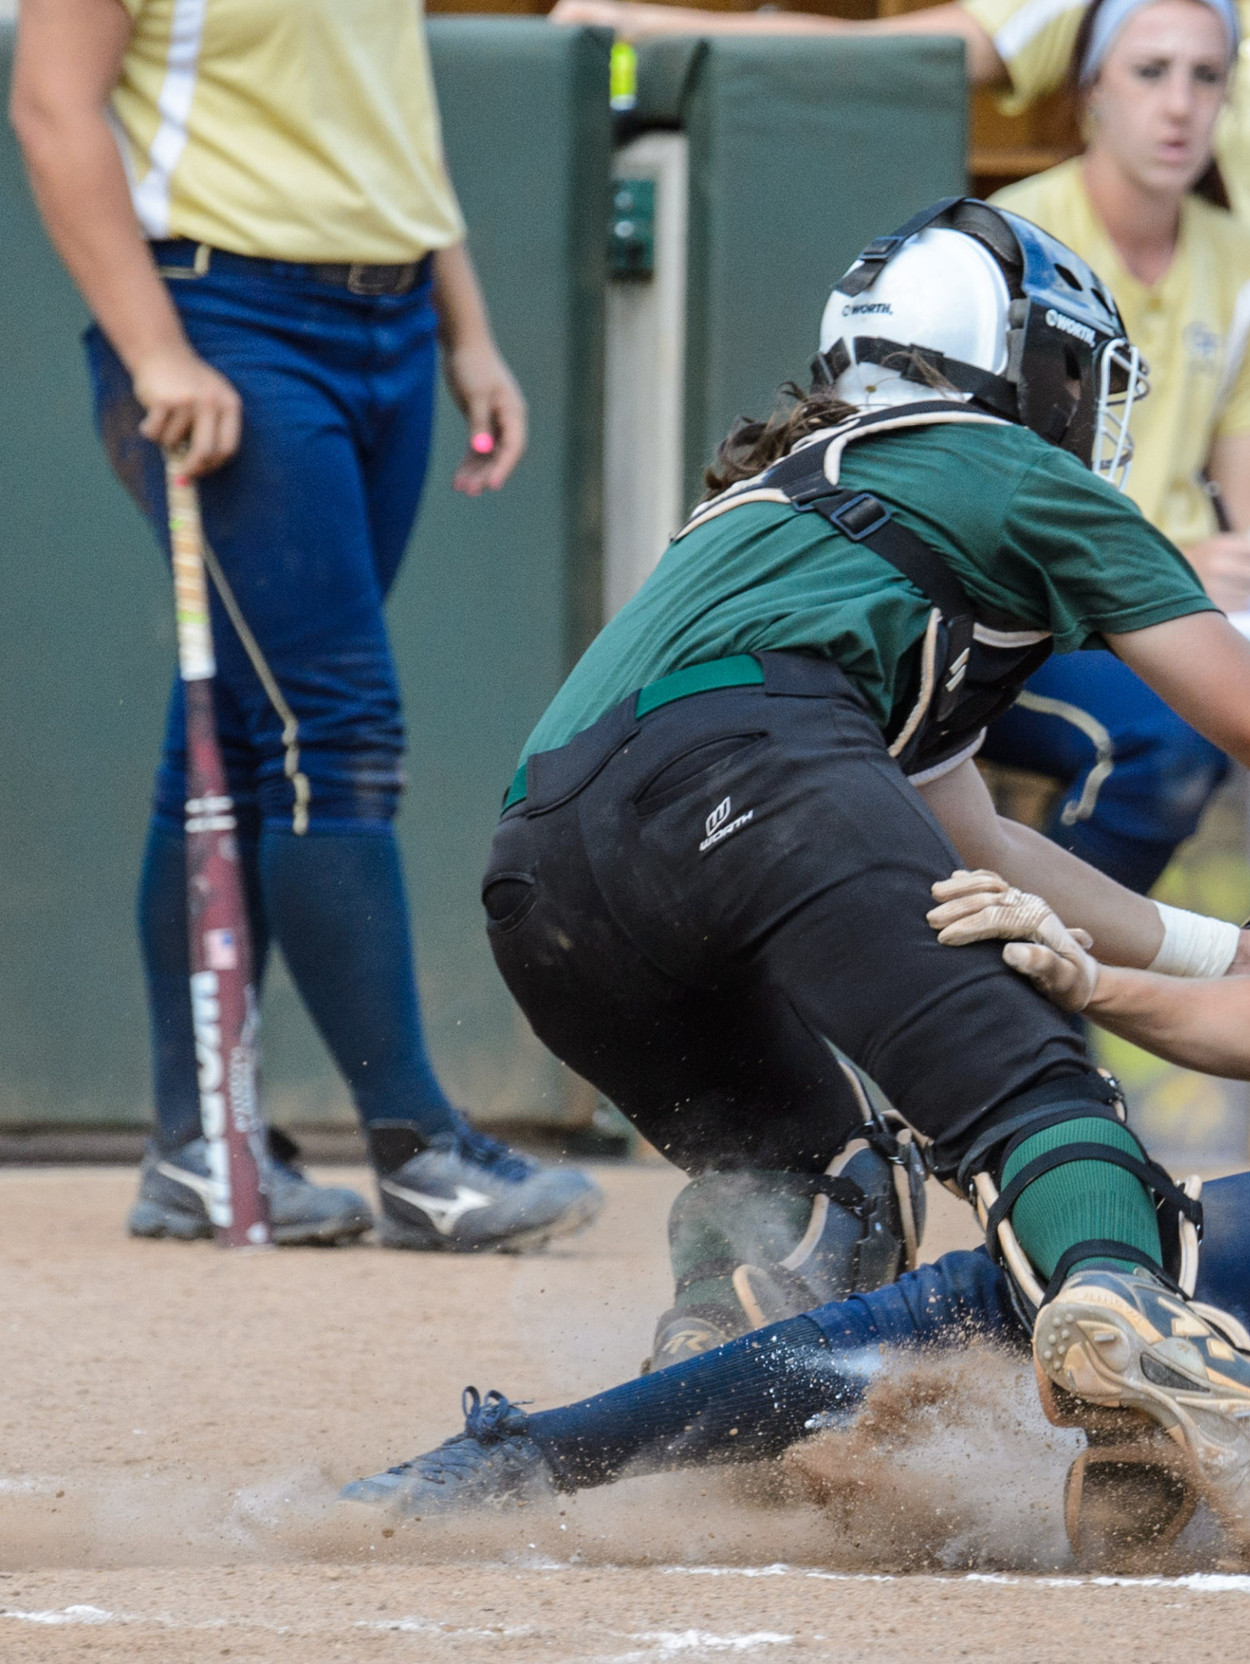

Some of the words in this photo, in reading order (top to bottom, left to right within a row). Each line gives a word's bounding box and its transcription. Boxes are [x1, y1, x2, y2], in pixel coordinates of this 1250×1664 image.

[852, 303, 892, 315] WORTH
[1055, 313, 1096, 344] WORTH
[699, 809, 754, 851] WORTH
